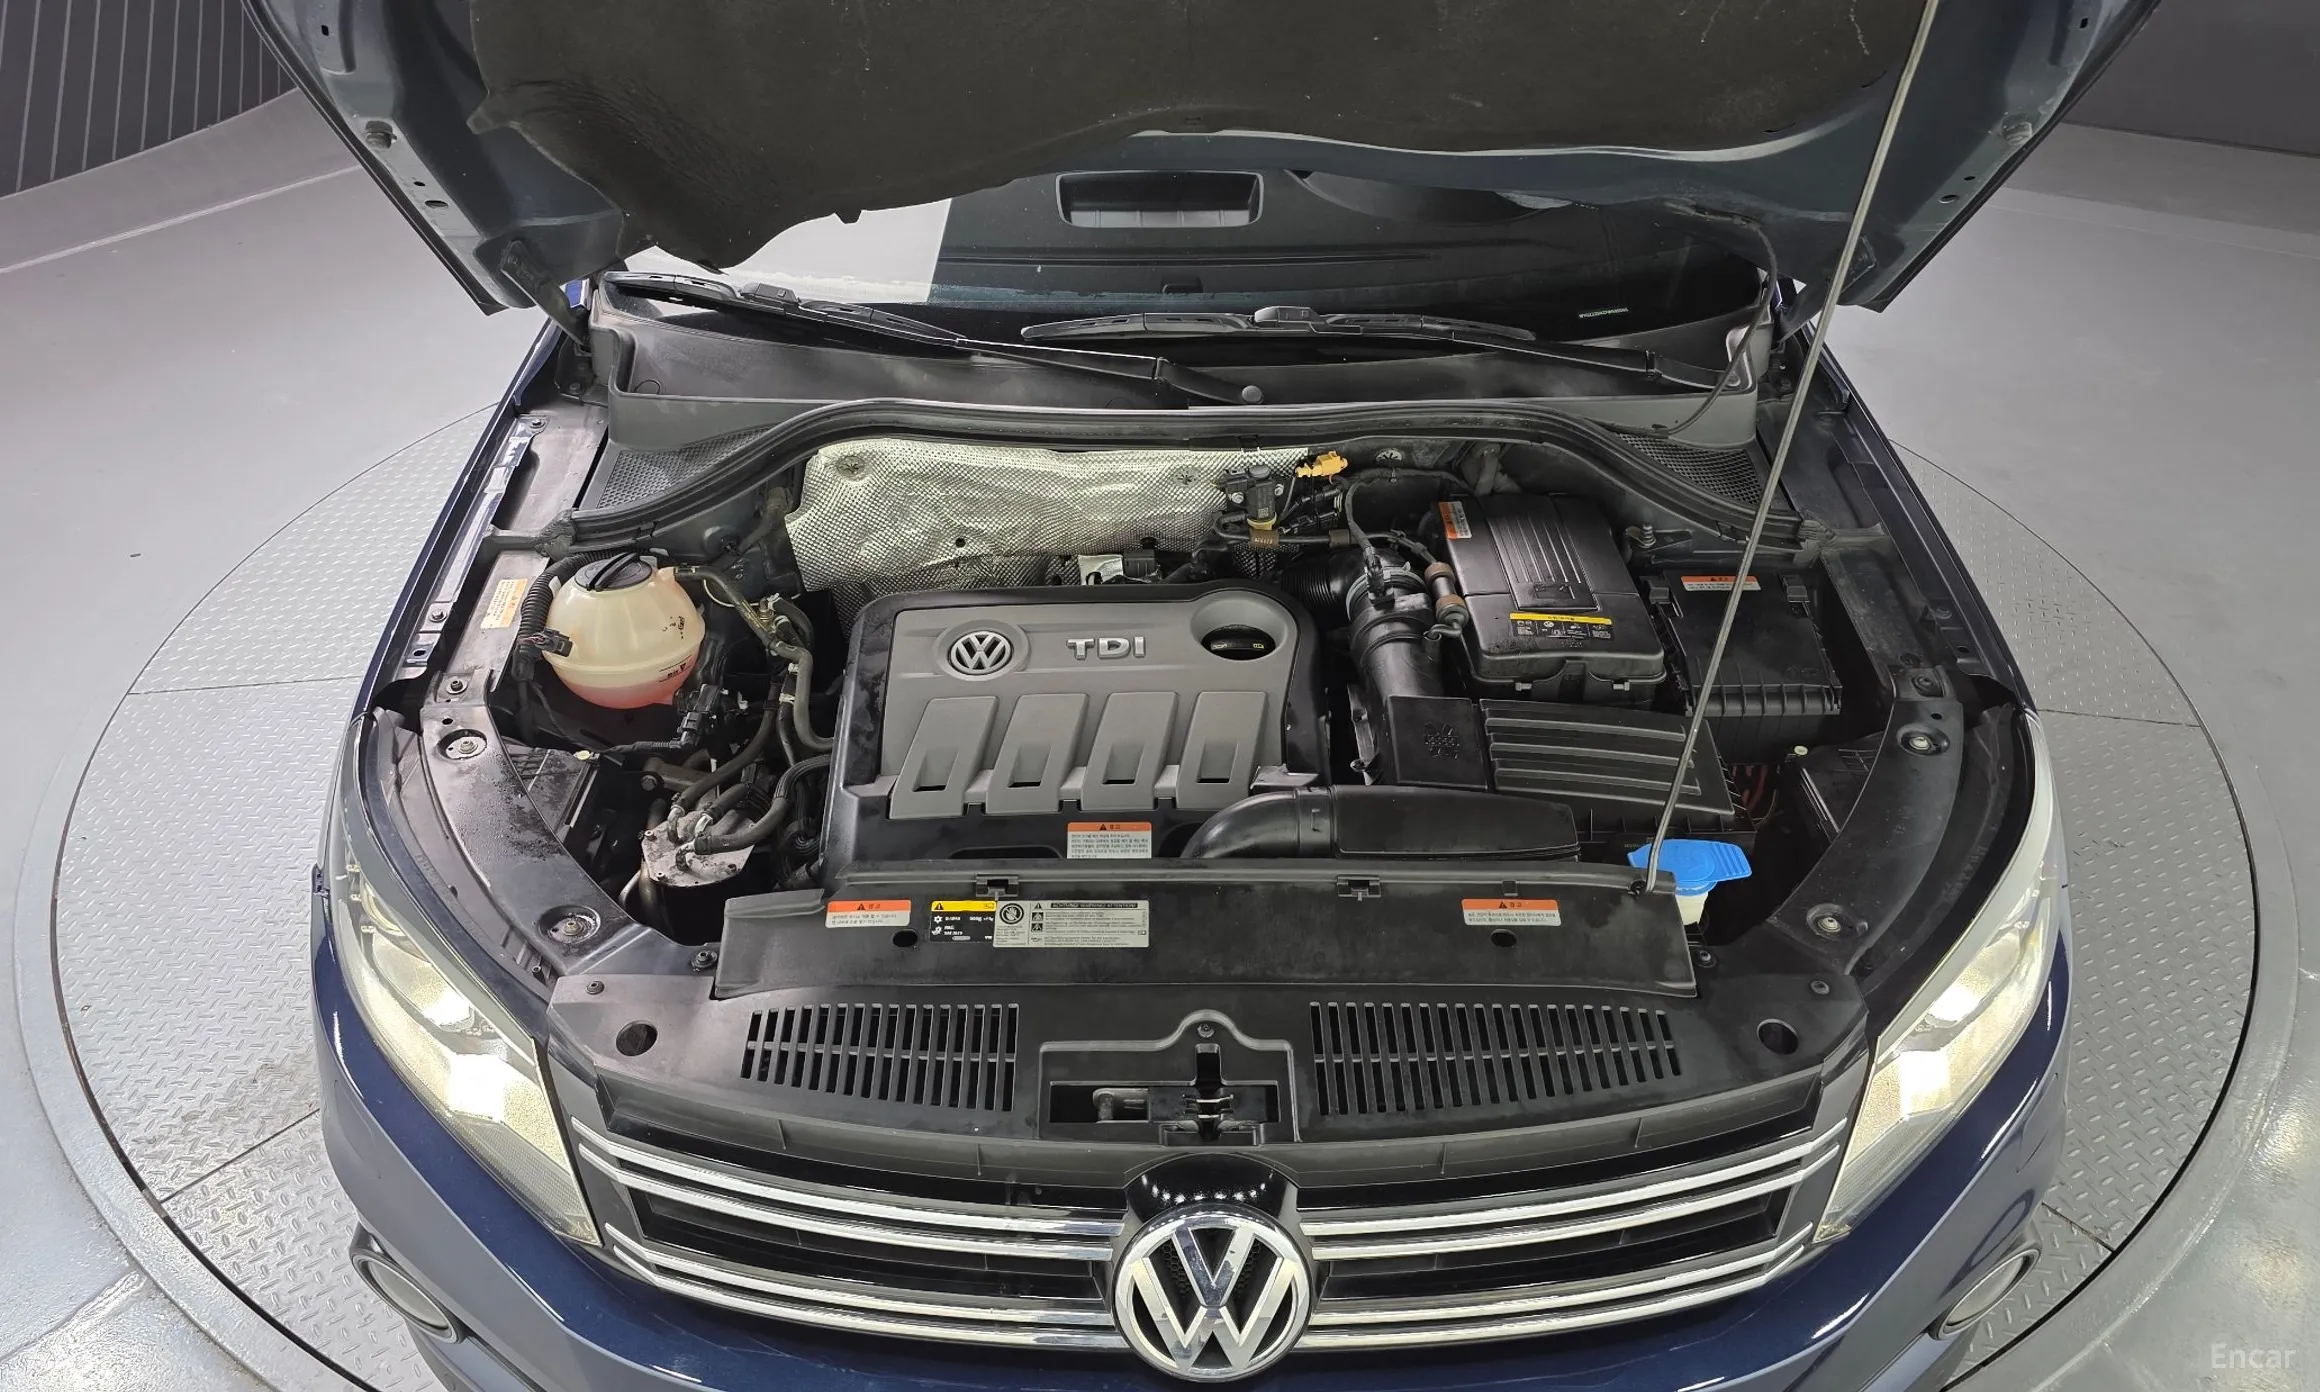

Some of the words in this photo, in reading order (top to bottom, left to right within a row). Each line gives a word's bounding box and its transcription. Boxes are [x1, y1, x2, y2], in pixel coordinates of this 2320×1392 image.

[952, 631, 1011, 674] VW
[1067, 636, 1147, 660] TDI
[1119, 1218, 1306, 1377] VW
